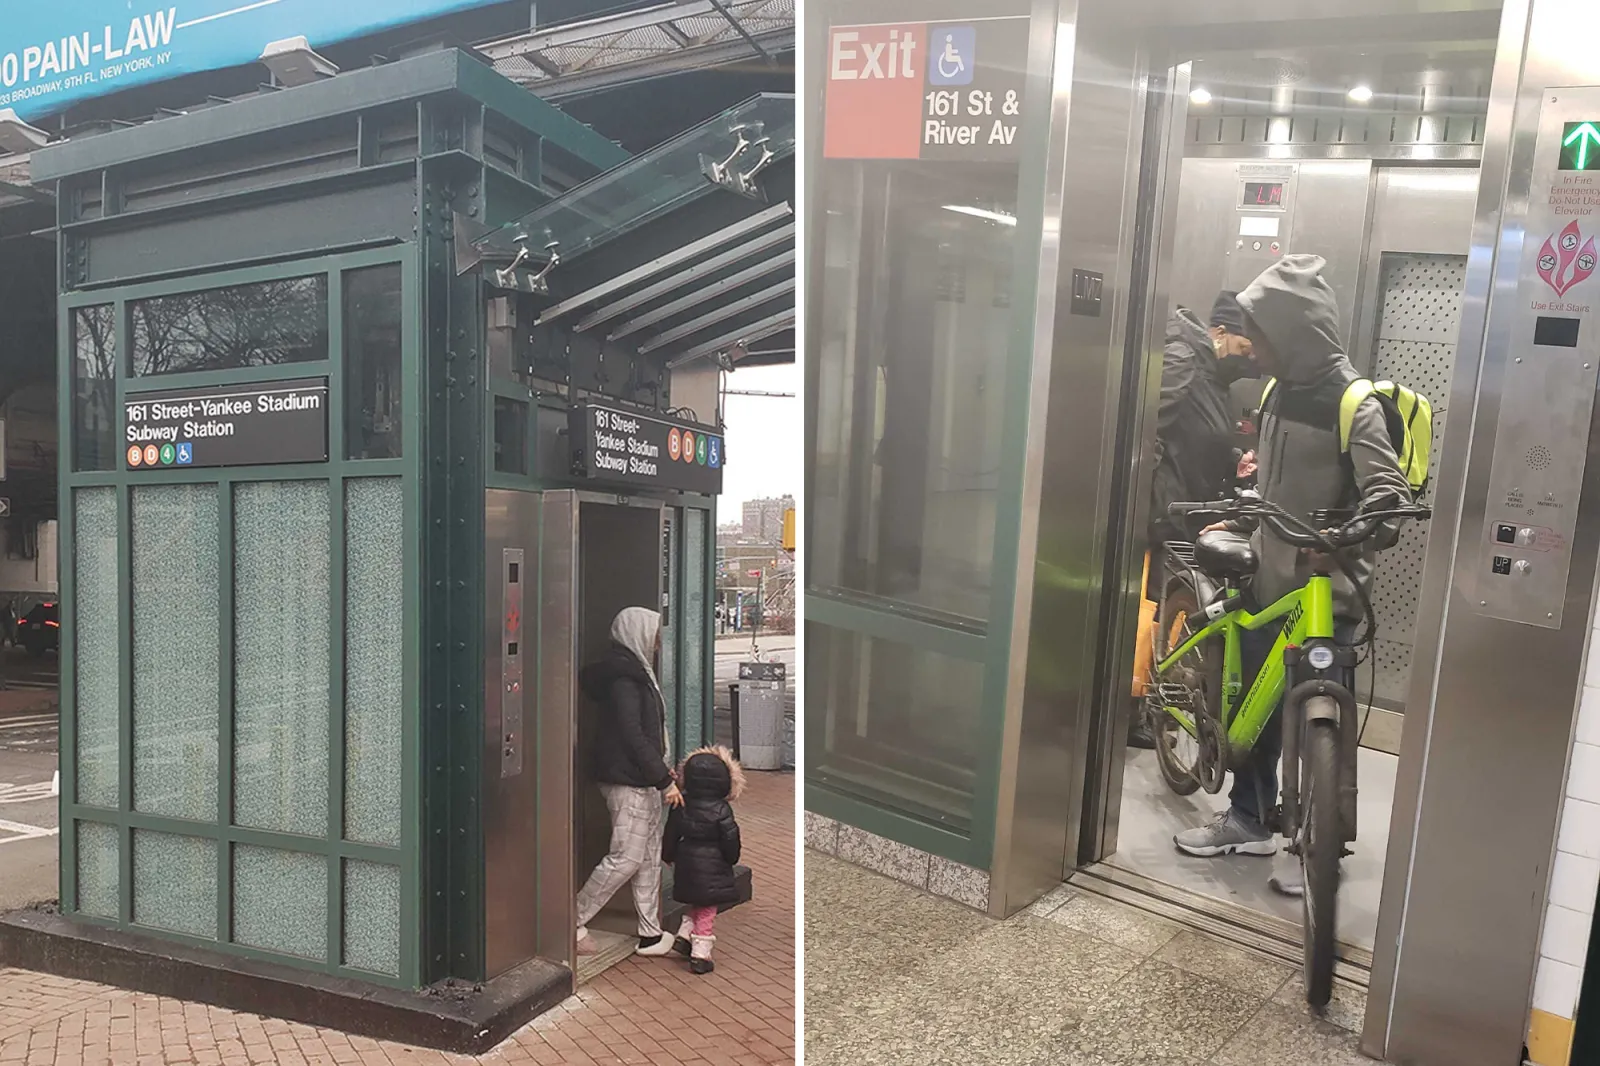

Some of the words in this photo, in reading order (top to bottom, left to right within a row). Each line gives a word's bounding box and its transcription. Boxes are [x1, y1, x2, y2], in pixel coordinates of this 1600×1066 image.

[0, 53, 18, 87] 0
[23, 7, 176, 82] PAIN-LAW
[831, 30, 916, 80] Exit
[12, 82, 62, 102] BROADWAY,
[64, 74, 83, 90] 9TH
[100, 64, 123, 80] NEW
[124, 58, 154, 73] YORK,
[156, 52, 172, 65] NY
[925, 91, 959, 116] 161
[967, 90, 993, 116] St
[1002, 90, 1019, 116] &
[924, 120, 980, 145] River
[987, 120, 1017, 145] Av
[1550, 186, 1600, 197] Emergency
[1563, 176, 1572, 184] In
[1574, 176, 1592, 185] Fire
[1548, 196, 1562, 205] Do
[1564, 196, 1581, 206] Not
[1583, 197, 1600, 206] Use
[1554, 206, 1592, 216] Elevator
[1530, 301, 1547, 310] Use
[1548, 302, 1564, 312] Exit
[1565, 303, 1590, 313] Stairs
[126, 405, 148, 421] 161
[151, 399, 252, 420] Street-Yankee
[257, 394, 320, 413] Stadium
[126, 425, 179, 442] Subway
[183, 420, 234, 439] Station
[595, 410, 608, 428] 161
[611, 413, 640, 434] Street-
[595, 430, 626, 452] Yankee
[627, 436, 659, 458] Stadium
[671, 434, 678, 453] B
[685, 438, 692, 457] D
[595, 450, 628, 474] Subway
[629, 456, 658, 476] Station
[1495, 557, 1508, 568] UP
